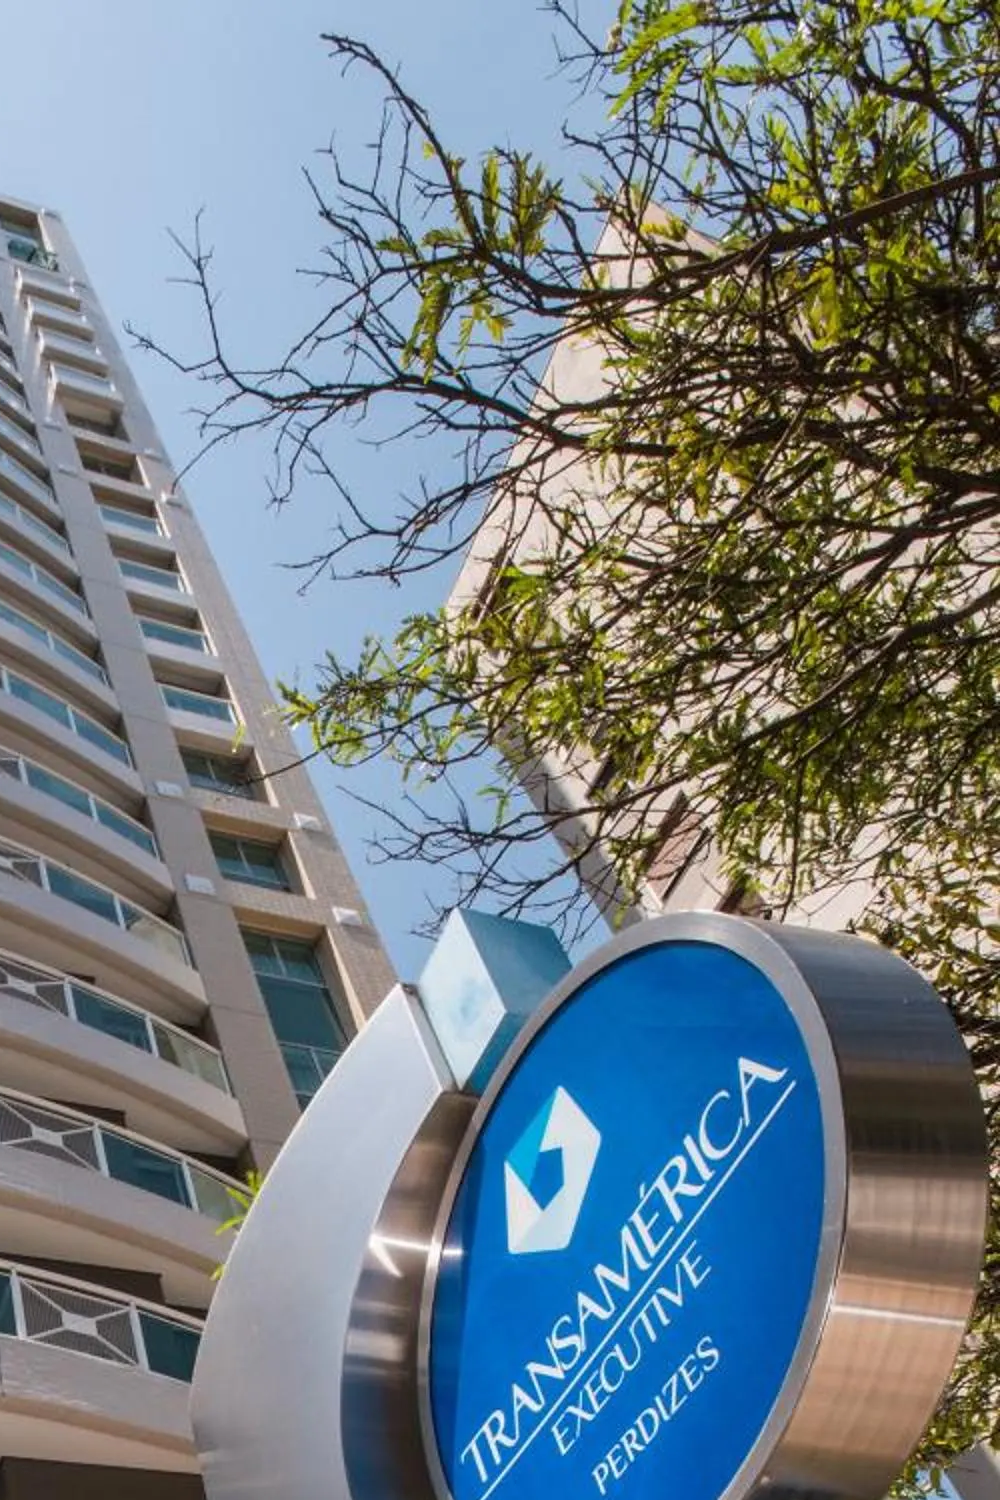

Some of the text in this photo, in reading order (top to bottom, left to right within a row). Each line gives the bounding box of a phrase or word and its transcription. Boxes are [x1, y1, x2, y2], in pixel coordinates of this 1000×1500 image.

[460, 1056, 789, 1483] TRANSAMÉRICA
[551, 1240, 712, 1456] EXECUTIVE
[591, 1335, 720, 1495] PERDIZES
